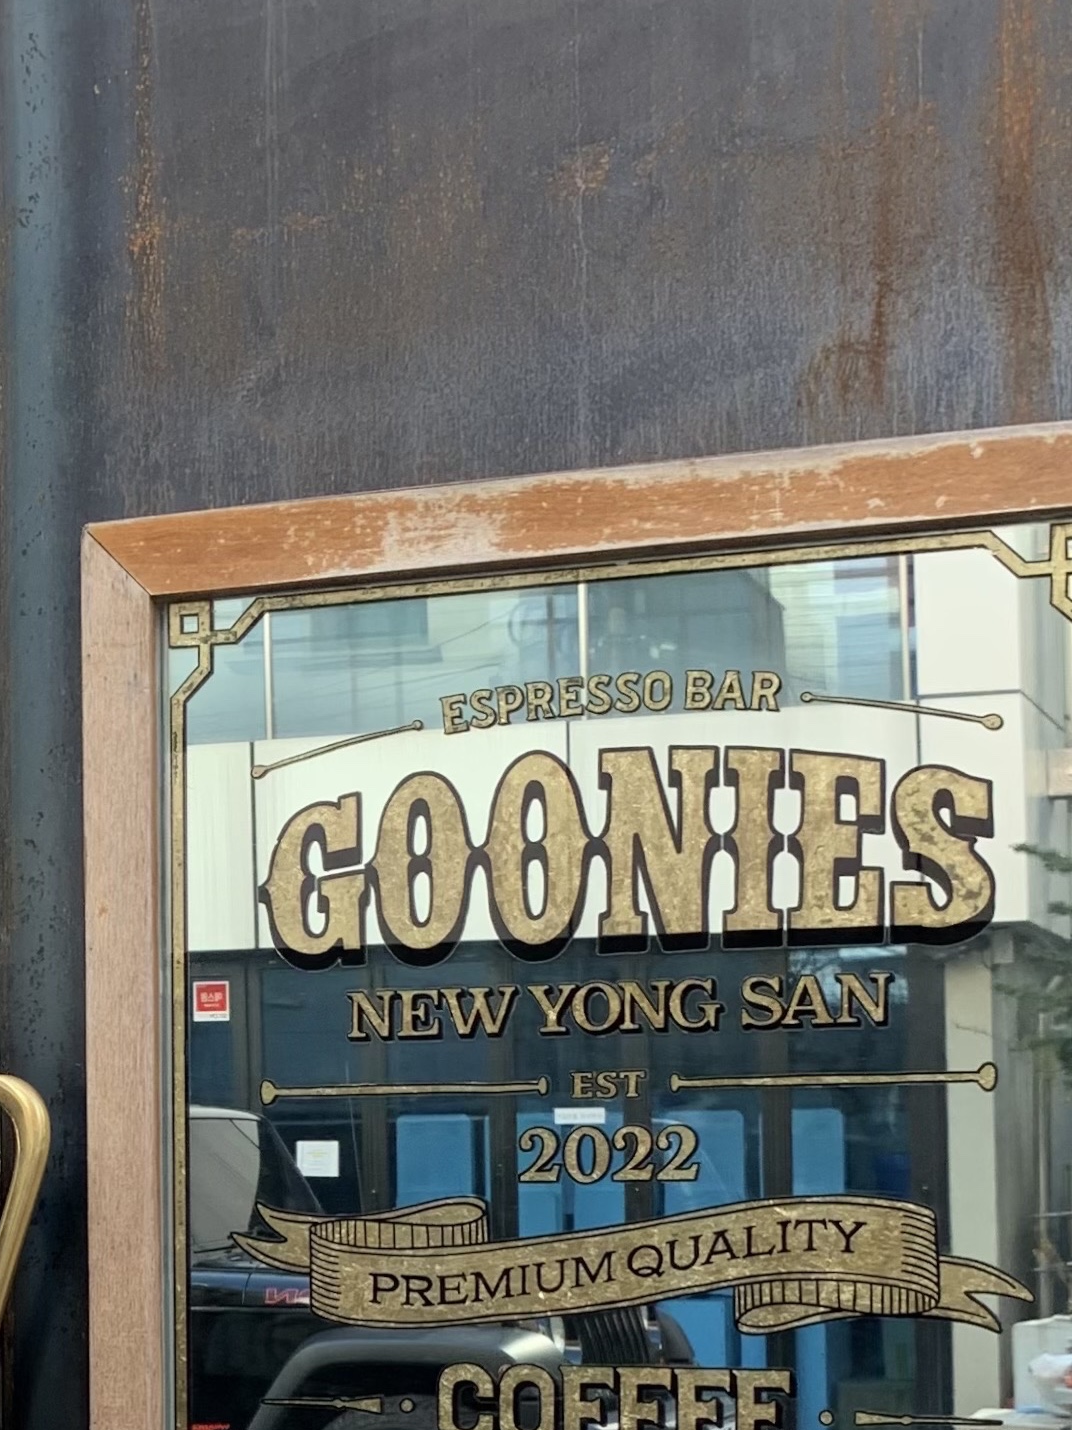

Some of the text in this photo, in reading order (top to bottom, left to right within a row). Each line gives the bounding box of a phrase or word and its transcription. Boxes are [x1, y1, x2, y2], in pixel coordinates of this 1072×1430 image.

[441, 669, 783, 734] ESPRESSO BAR
[259, 745, 995, 968] GOONIES
[348, 970, 890, 1042] NEW YONG SAN
[570, 1070, 647, 1102] EST
[517, 1124, 701, 1184] 2022
[369, 1217, 867, 1306] PREMIUM QUALITY
